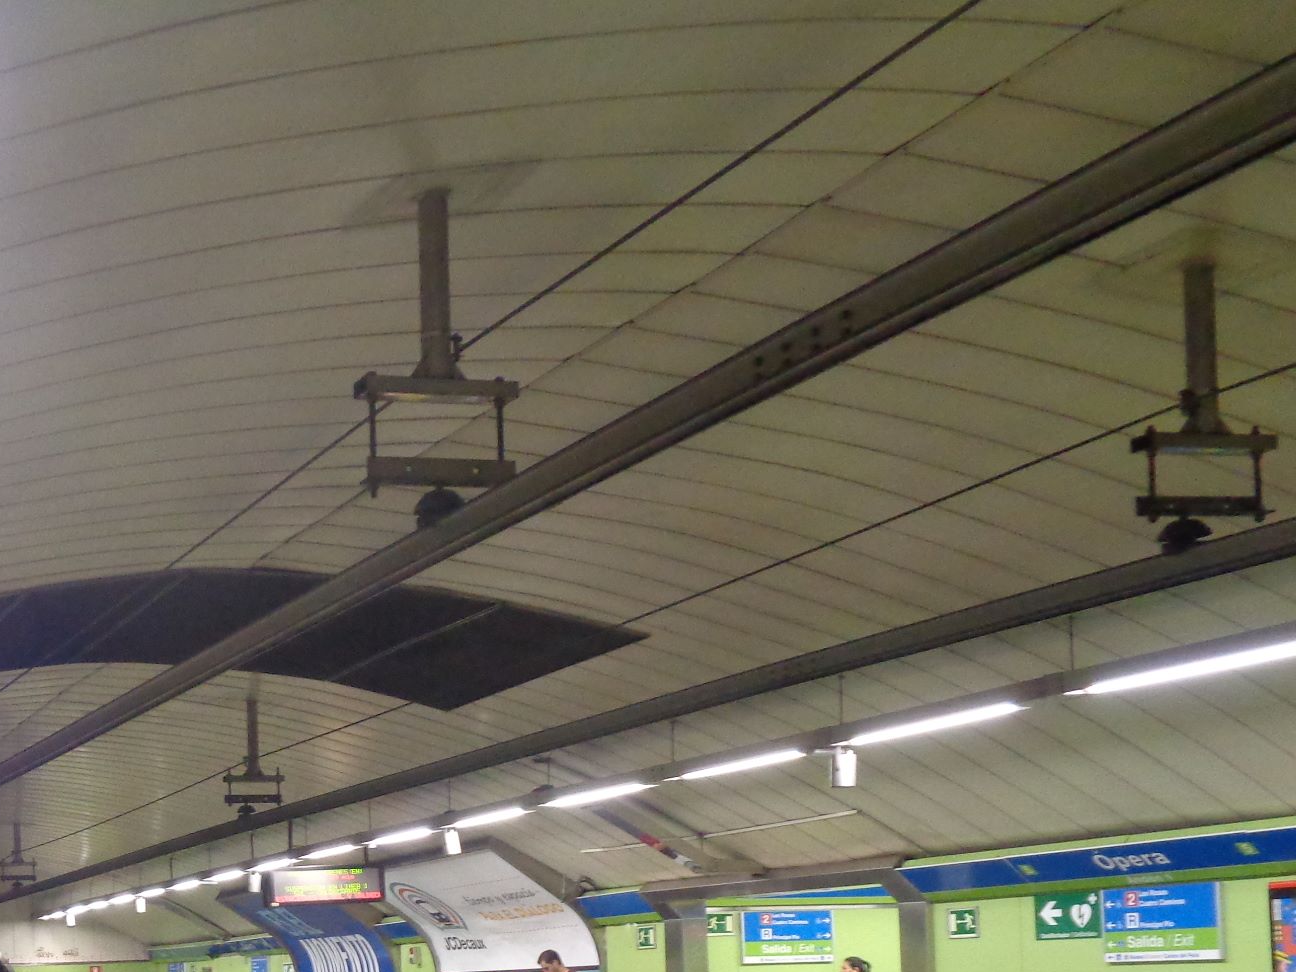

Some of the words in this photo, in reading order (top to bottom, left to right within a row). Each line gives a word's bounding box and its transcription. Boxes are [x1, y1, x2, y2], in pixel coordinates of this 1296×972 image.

[1093, 850, 1171, 871] Ópera
[1127, 893, 1136, 906] 2
[761, 914, 771, 924] 2
[445, 936, 487, 951] JCDecaux
[1127, 934, 1164, 949] Salida
[1173, 933, 1195, 947] Exit
[761, 944, 792, 954] Salida
[799, 943, 815, 952] Exit
